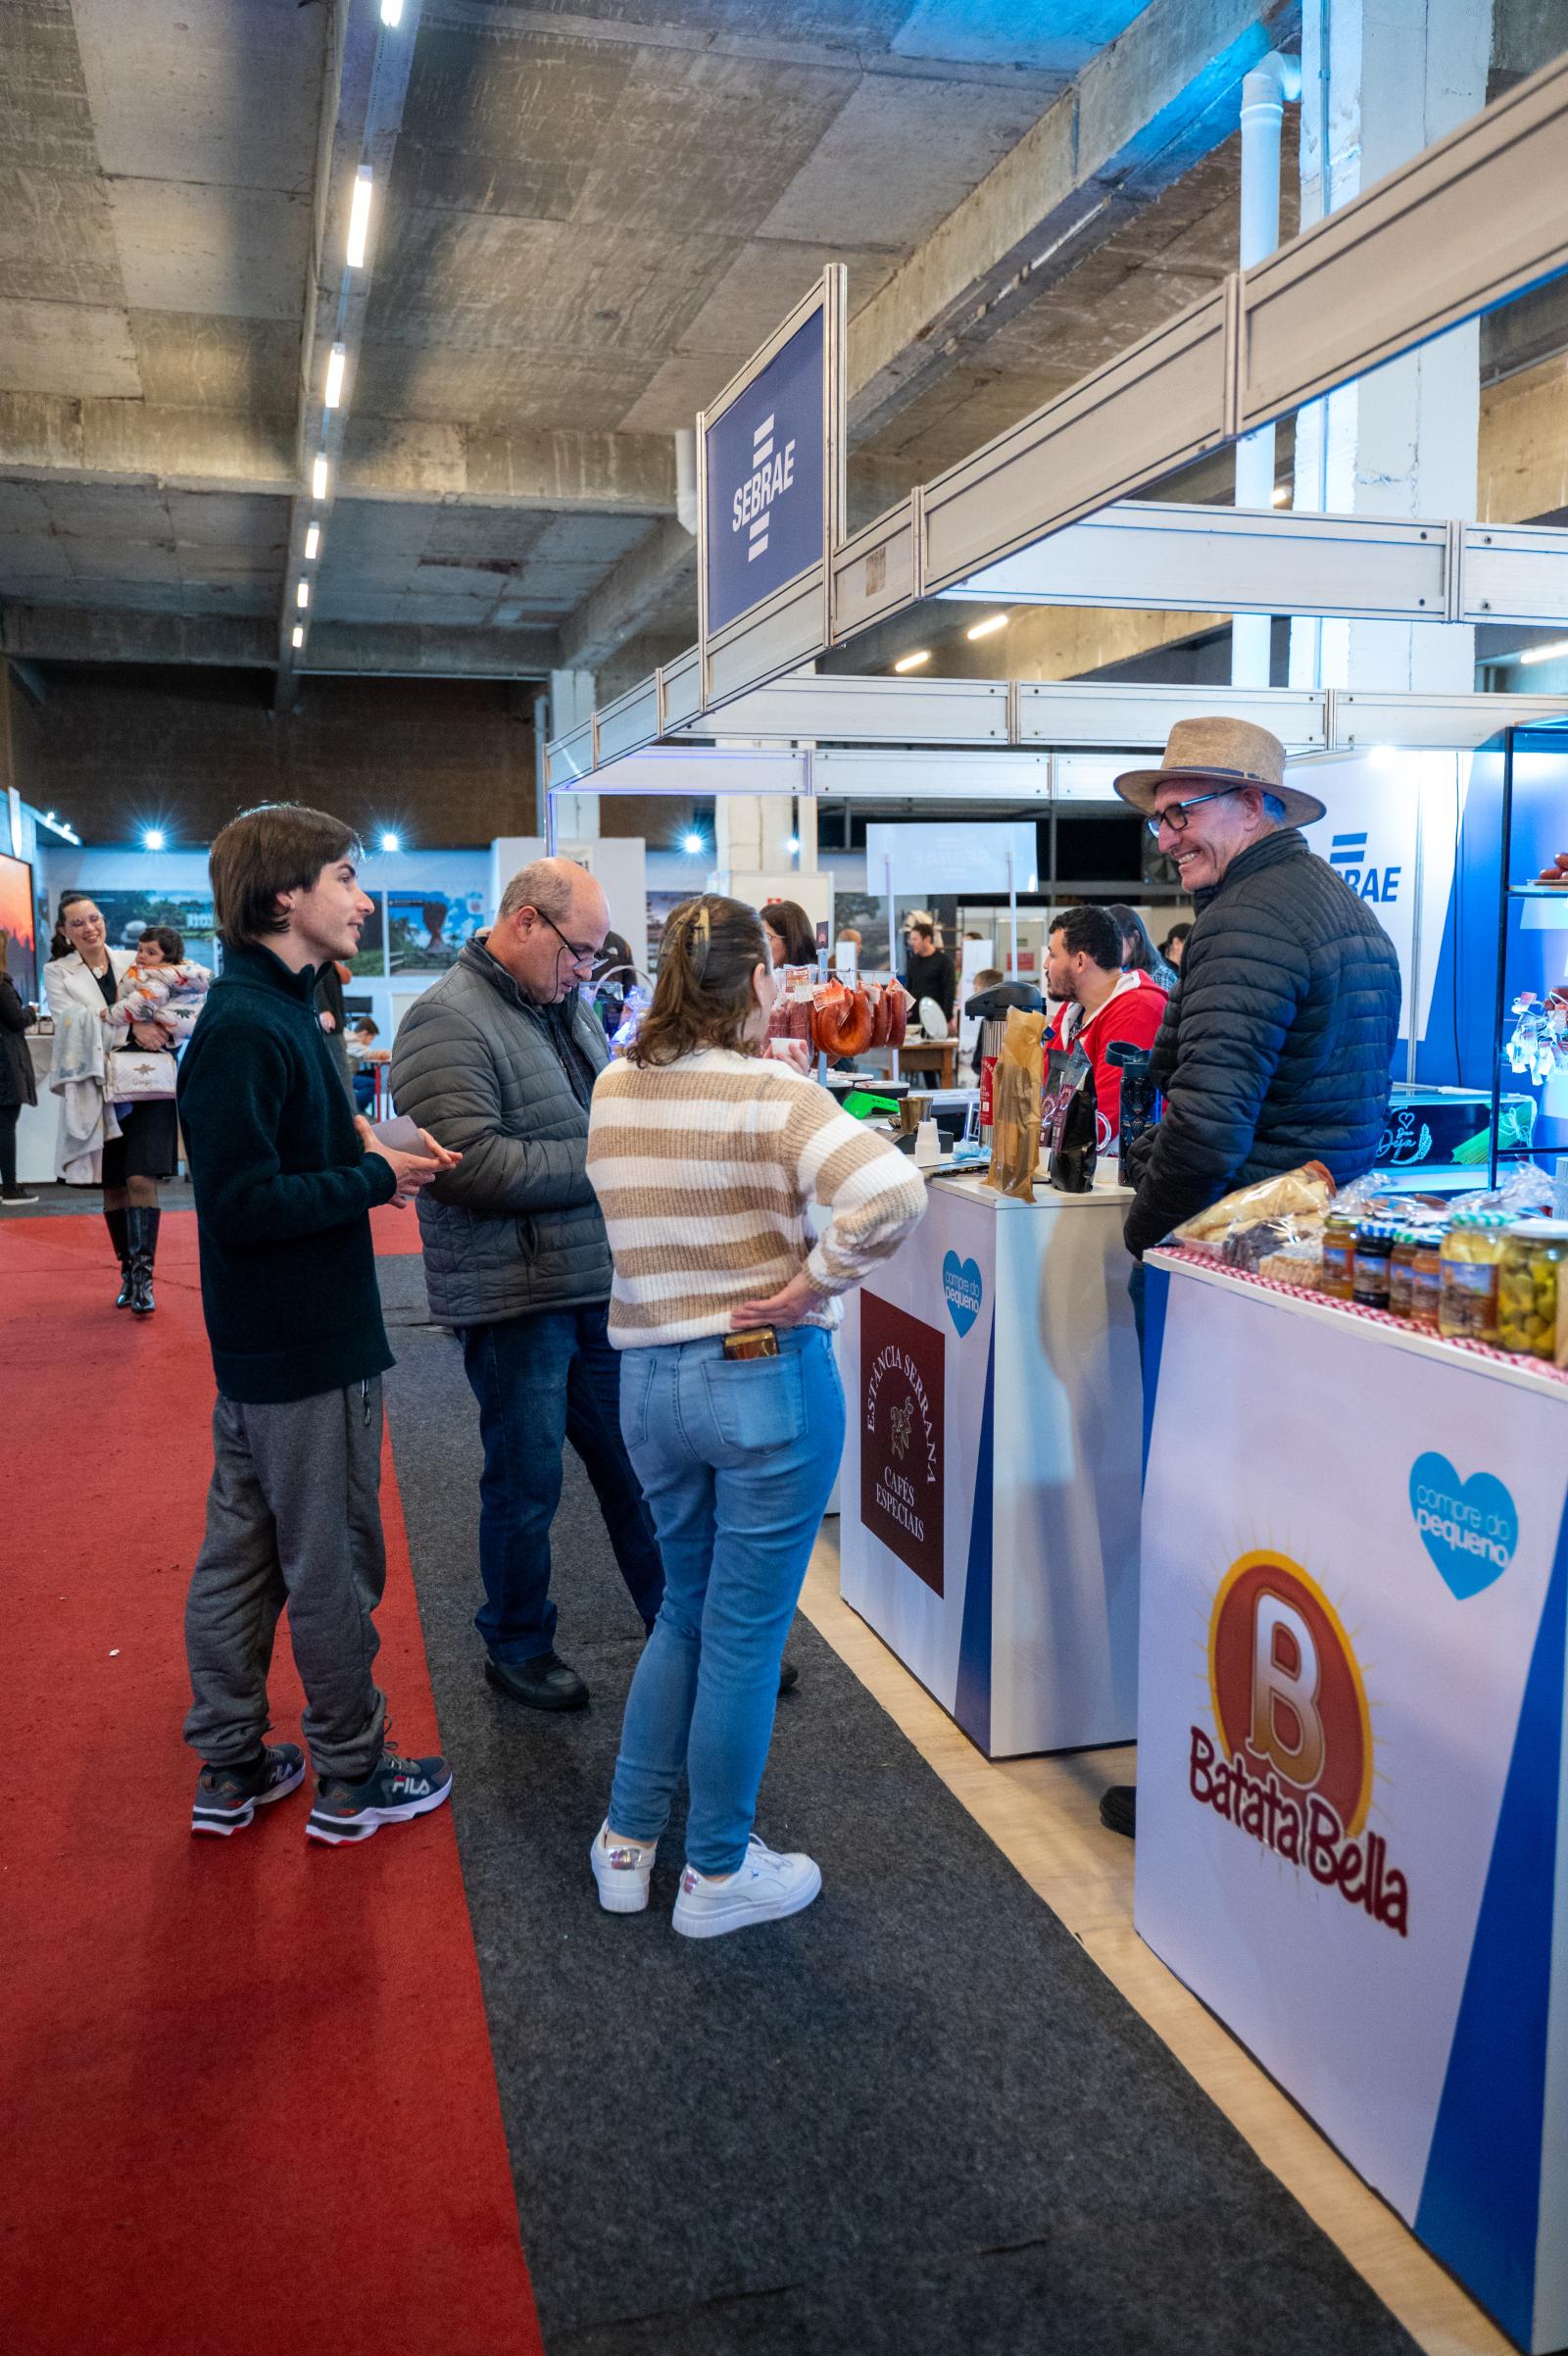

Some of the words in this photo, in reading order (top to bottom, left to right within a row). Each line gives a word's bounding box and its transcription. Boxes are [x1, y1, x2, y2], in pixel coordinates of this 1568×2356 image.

[732, 438, 796, 532] SEBRAE
[945, 1271, 969, 1293] compre
[970, 1279, 980, 1298] do
[945, 1285, 980, 1313] pequeno
[867, 1345, 903, 1434] ESTÂNCIA
[904, 1354, 937, 1483] SERRANA
[876, 1482, 924, 1543] ESPECIAIS
[884, 1465, 914, 1507] CAFÉS
[1417, 1485, 1482, 1529] compre
[1486, 1513, 1510, 1542] do
[1417, 1507, 1510, 1568] pequeno
[1246, 1587, 1325, 1791] B
[392, 1775, 431, 1795] FILA
